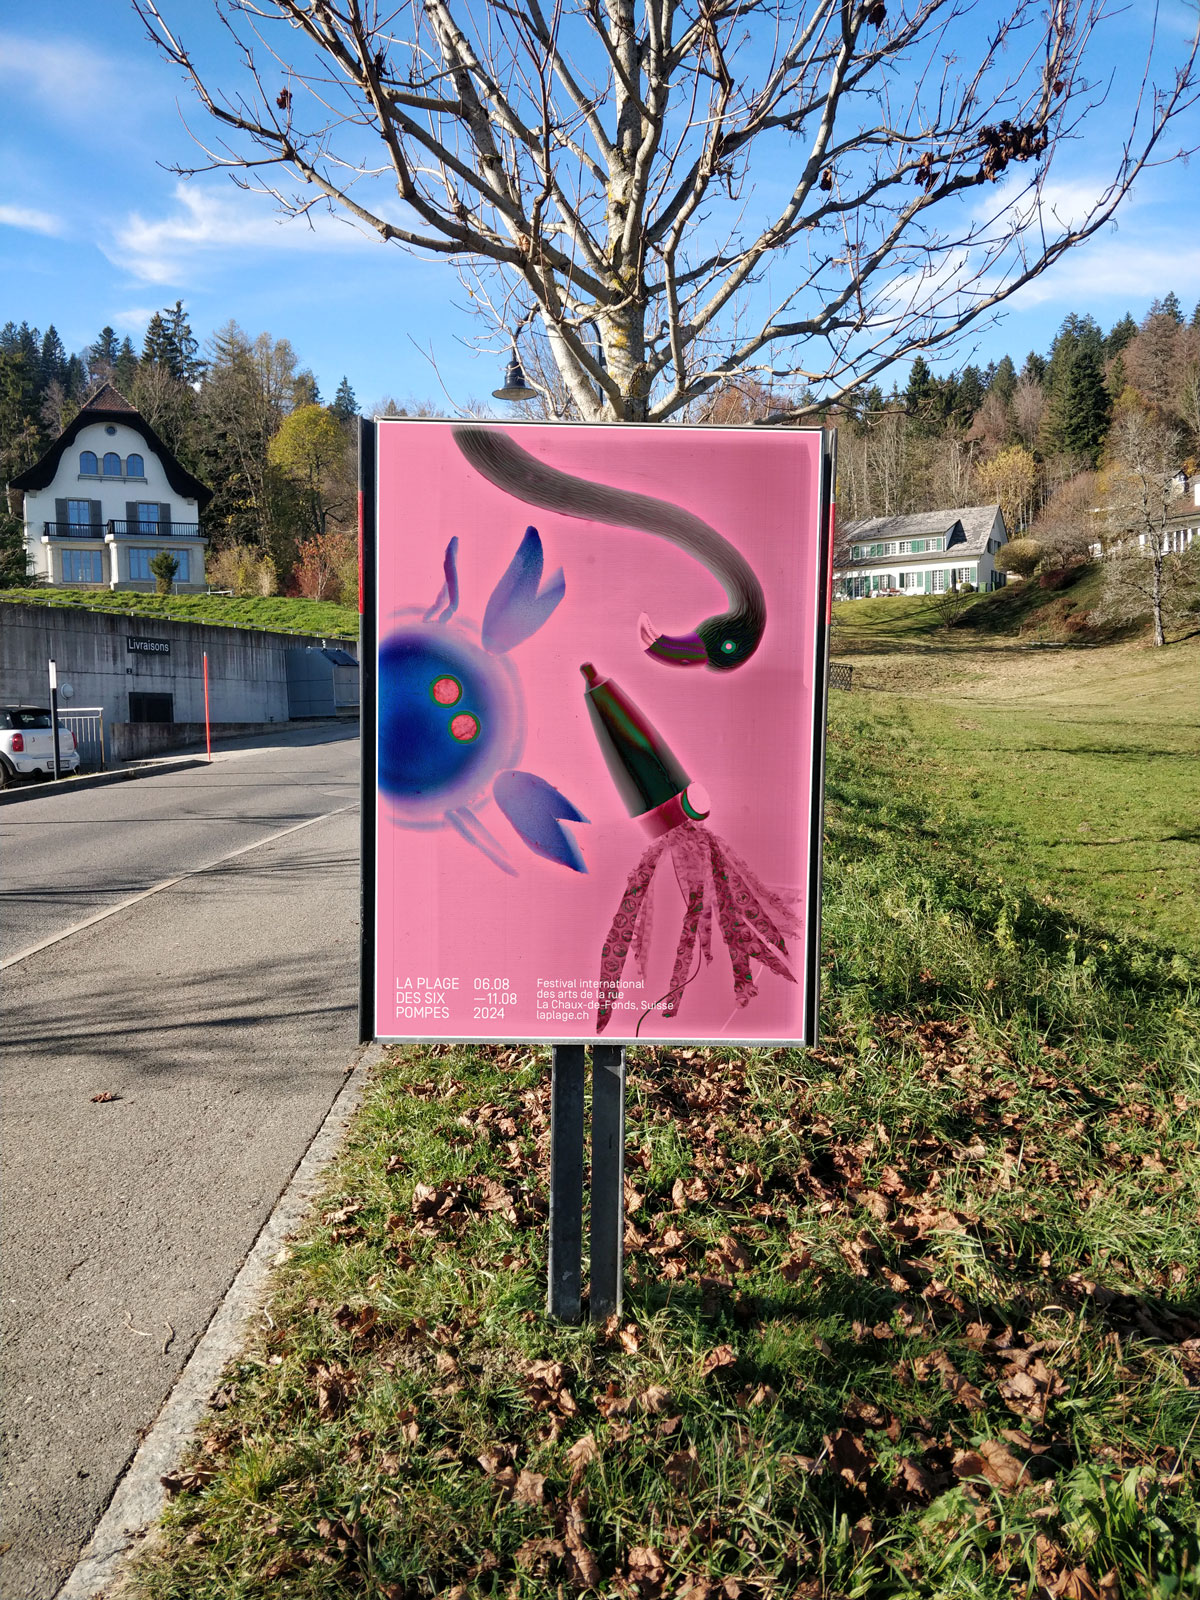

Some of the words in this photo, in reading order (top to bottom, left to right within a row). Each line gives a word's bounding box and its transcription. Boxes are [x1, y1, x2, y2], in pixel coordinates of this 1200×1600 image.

[128, 638, 169, 652] Livraisons
[396, 977, 413, 990] LA
[416, 978, 460, 990] PLAGE
[473, 978, 510, 990] 06.08
[536, 978, 577, 989] Festival
[579, 978, 644, 990] international
[396, 992, 422, 1004] DES
[424, 992, 445, 1004] SIX
[536, 989, 554, 999] des
[557, 990, 577, 1000] arts
[580, 990, 592, 1000] de
[596, 990, 605, 1000] la
[608, 992, 624, 1000] rue
[536, 1000, 549, 1010] La
[551, 1000, 638, 1011] Chaux-de-Fonds,
[641, 1000, 674, 1010] Suisse
[396, 1006, 450, 1018] POMPES
[473, 1008, 505, 1019] 2024
[536, 1010, 590, 1021] laplage.ch
